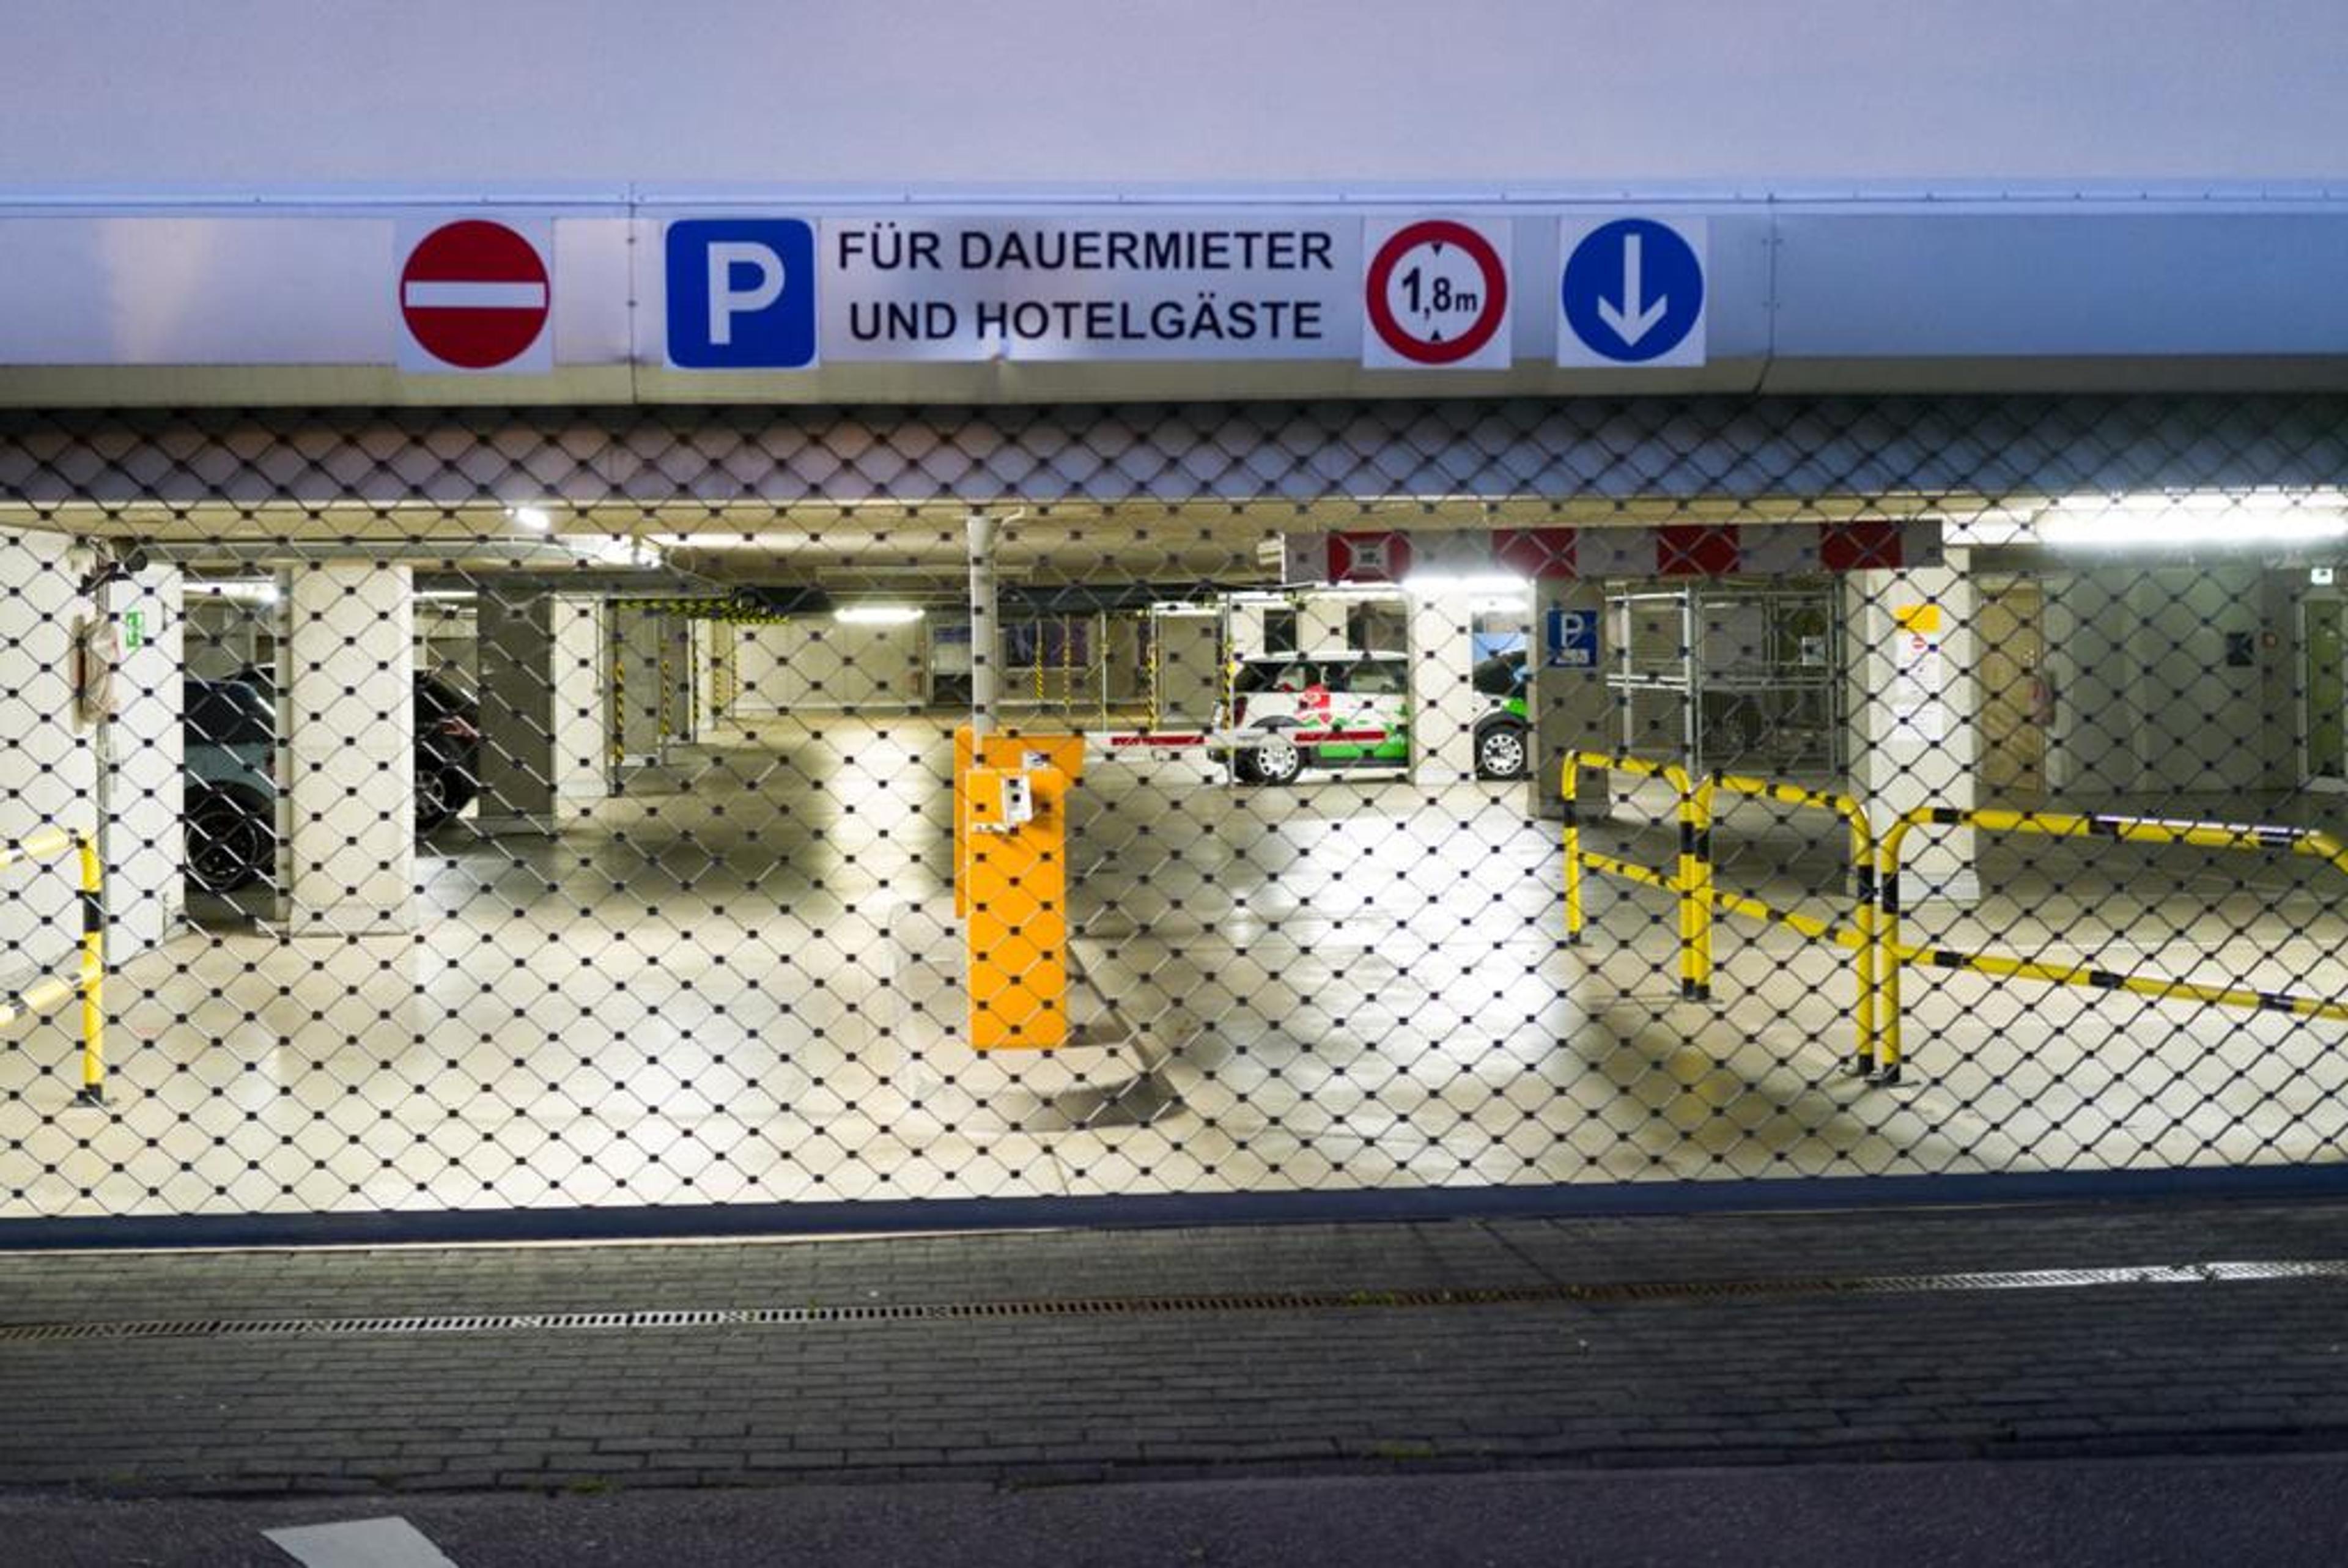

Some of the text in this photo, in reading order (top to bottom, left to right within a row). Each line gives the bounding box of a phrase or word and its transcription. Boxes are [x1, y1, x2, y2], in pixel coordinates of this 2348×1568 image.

[839, 221, 1334, 271] FÜR DAUERMIETER
[708, 242, 785, 345] P
[850, 291, 1323, 342] UND HOTELGÄSTE
